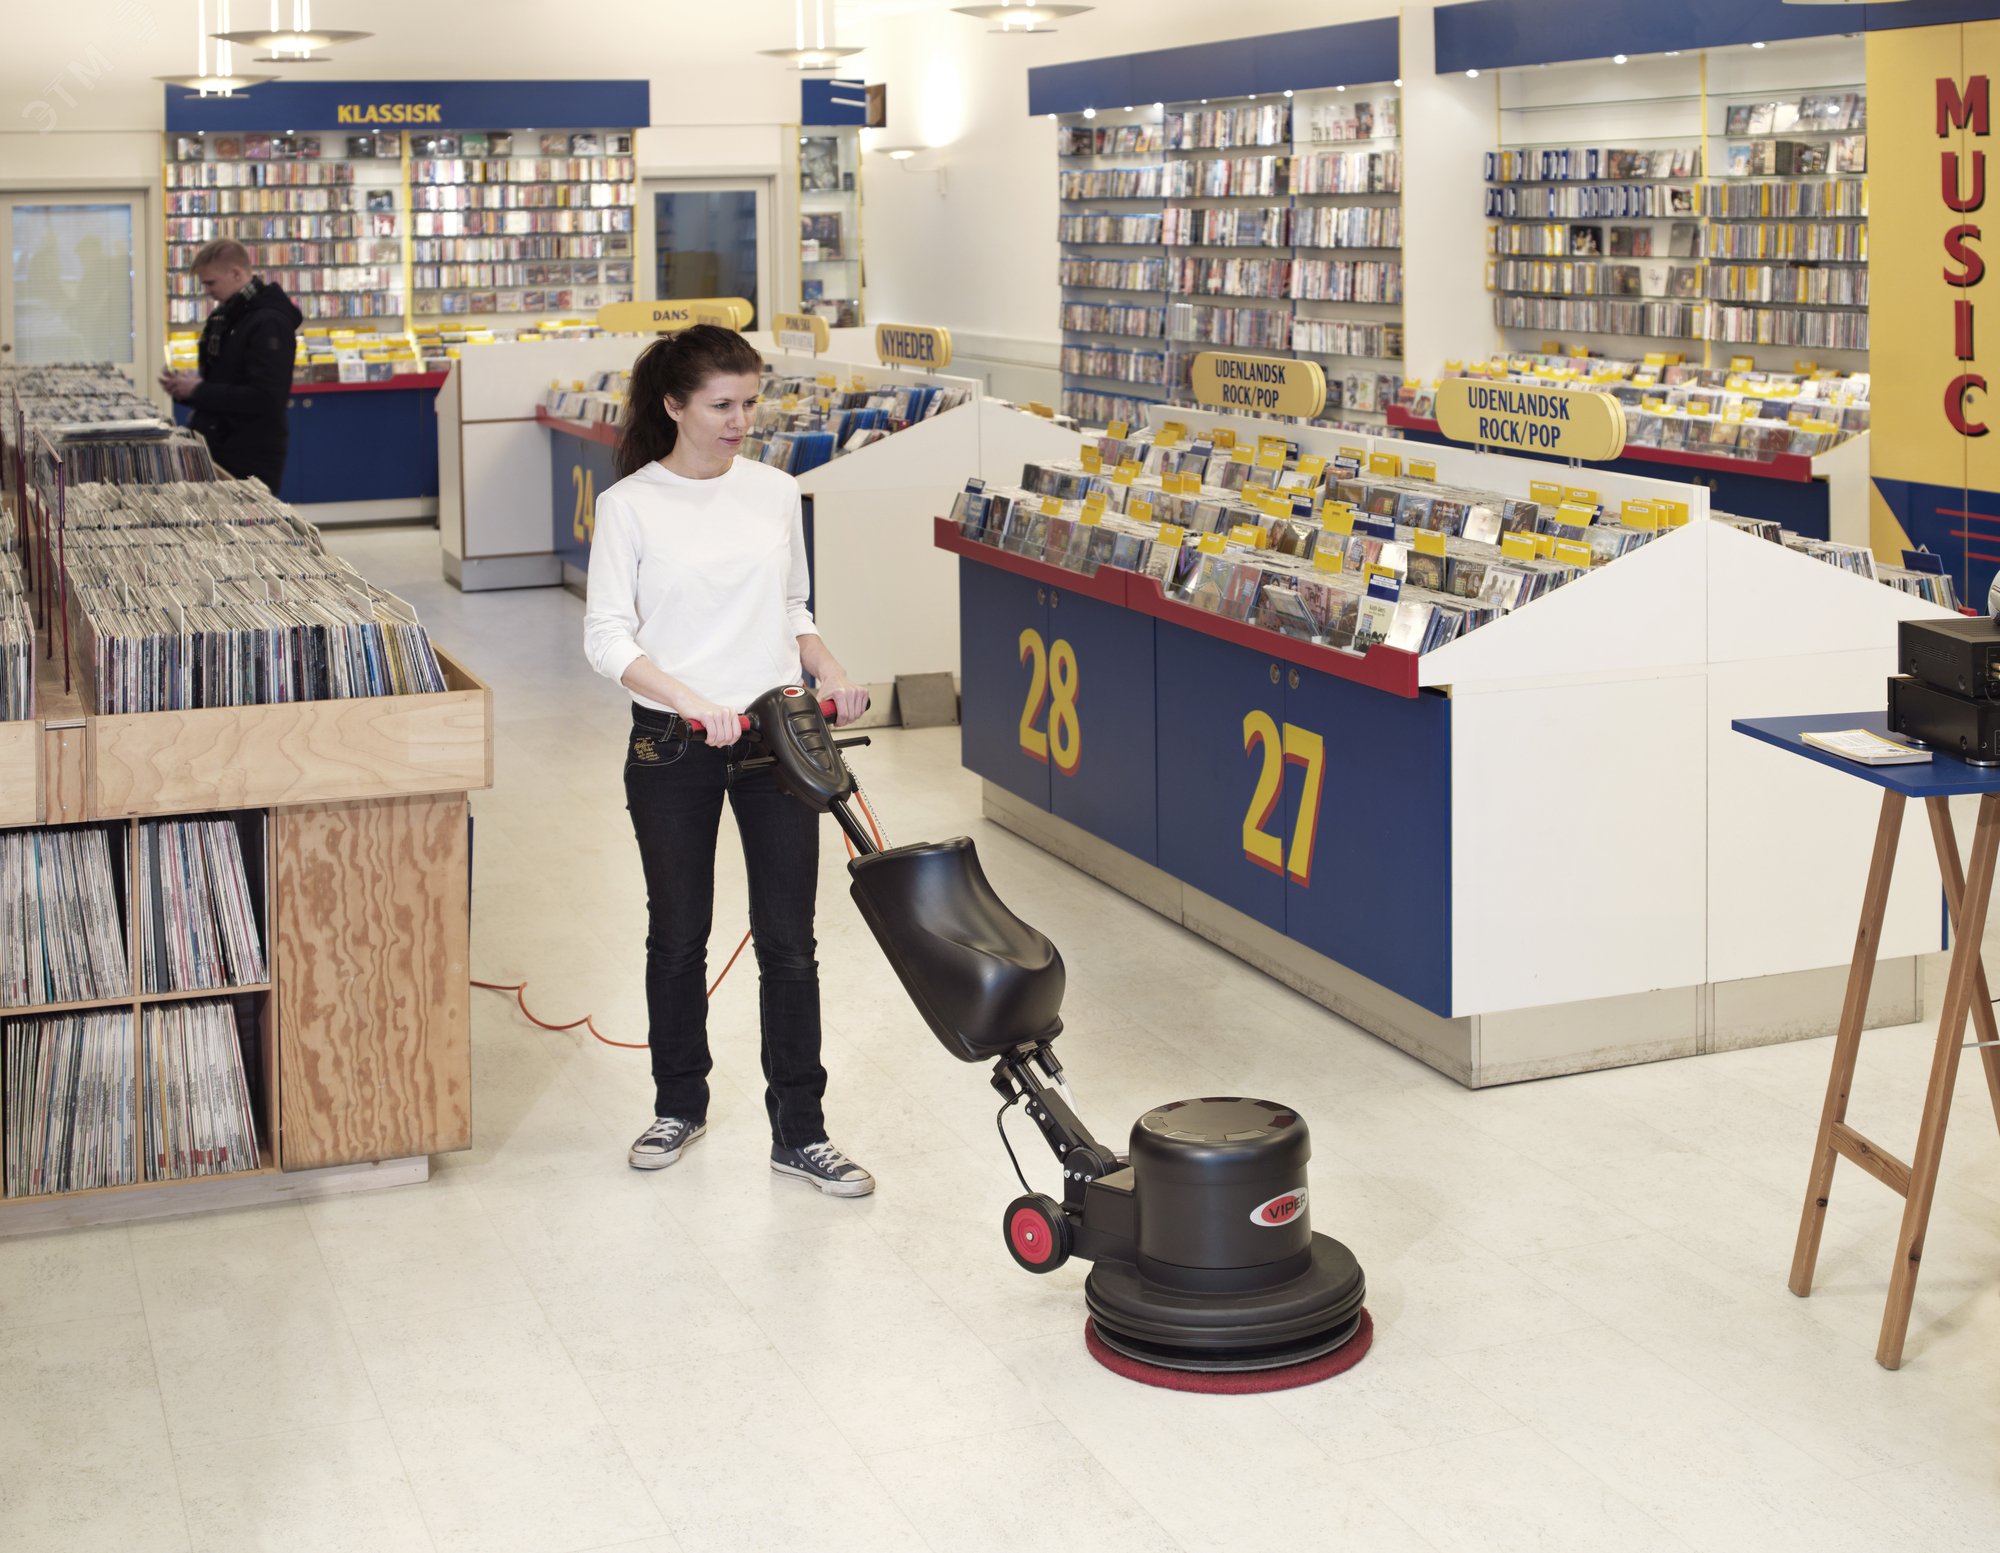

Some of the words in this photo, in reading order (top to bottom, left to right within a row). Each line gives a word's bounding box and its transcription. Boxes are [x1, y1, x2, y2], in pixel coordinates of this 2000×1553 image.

[337, 103, 441, 124] KLASSISK
[1935, 75, 1990, 438] MUSIC
[652, 308, 689, 322] DANS
[881, 328, 935, 362] NYHEDER
[1215, 359, 1286, 385] UDENLANDSK
[1222, 383, 1279, 409] ROCK/POP
[1468, 386, 1570, 421] UDENLANDSK
[1479, 416, 1562, 449] ROCK/POP
[1018, 628, 1081, 777] 28
[1242, 710, 1326, 889] 27
[1269, 1193, 1306, 1219] VIPER
